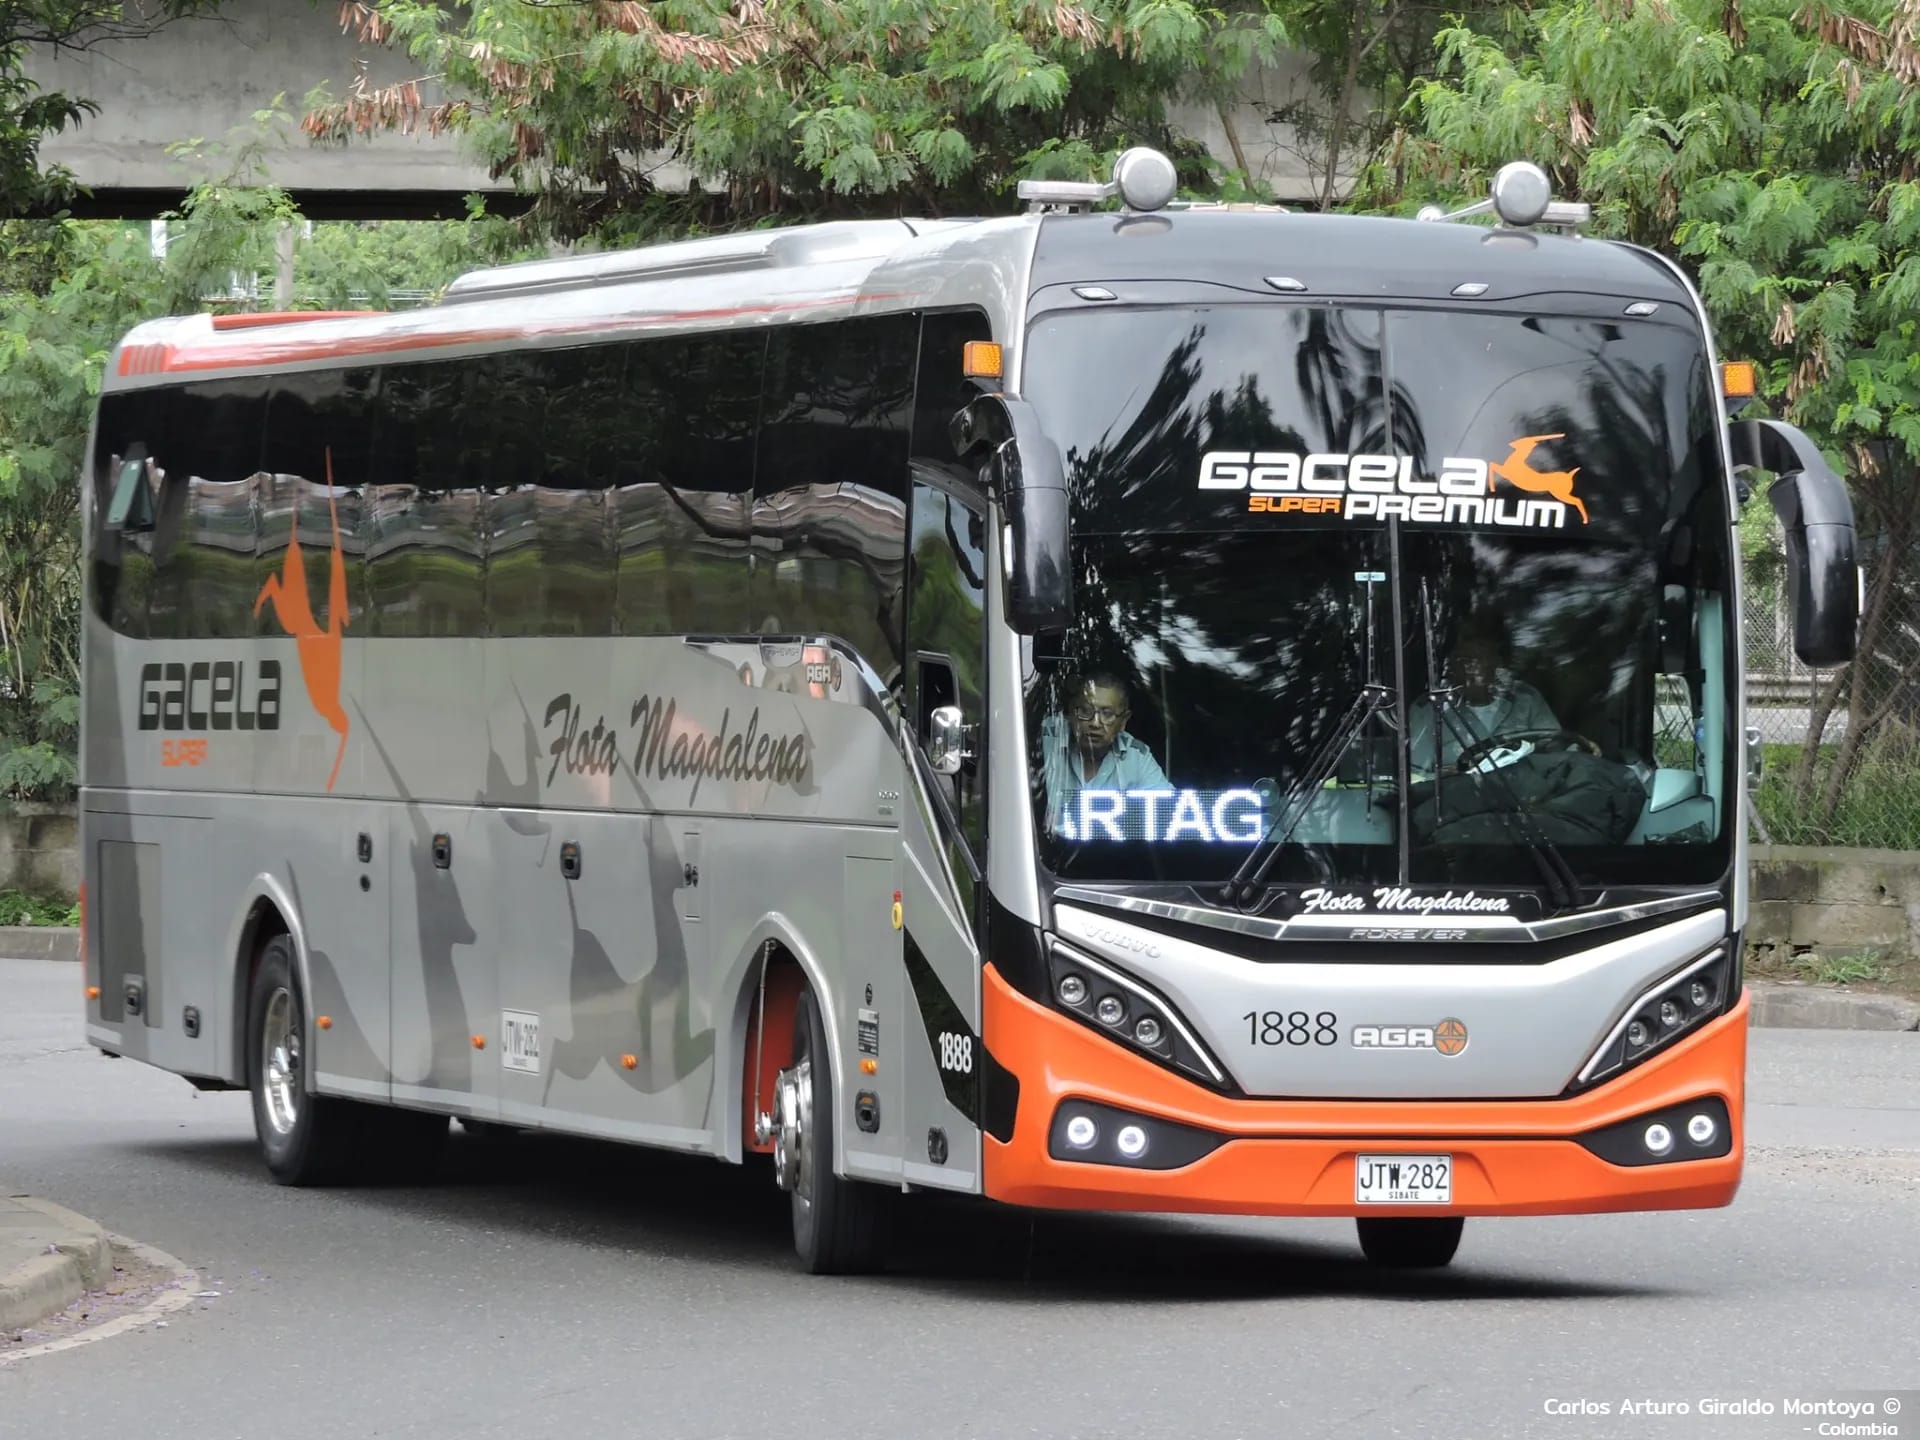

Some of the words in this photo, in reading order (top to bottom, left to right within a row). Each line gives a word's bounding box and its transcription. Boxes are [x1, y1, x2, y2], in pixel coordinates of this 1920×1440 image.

[1248, 496, 1340, 514] SUPER
[1344, 494, 1566, 528] PREMIUM
[806, 664, 831, 682] AGA
[544, 693, 619, 788] Flota
[630, 694, 808, 808] Magdalena
[1300, 888, 1366, 914] Flota
[1373, 886, 1511, 916] Magdalena
[1349, 928, 1467, 940] FOREVER
[1243, 1011, 1338, 1046] 1888
[1353, 1027, 1434, 1047] AGA
[939, 1031, 972, 1074] 1888
[1388, 1191, 1420, 1199] SIBATE
